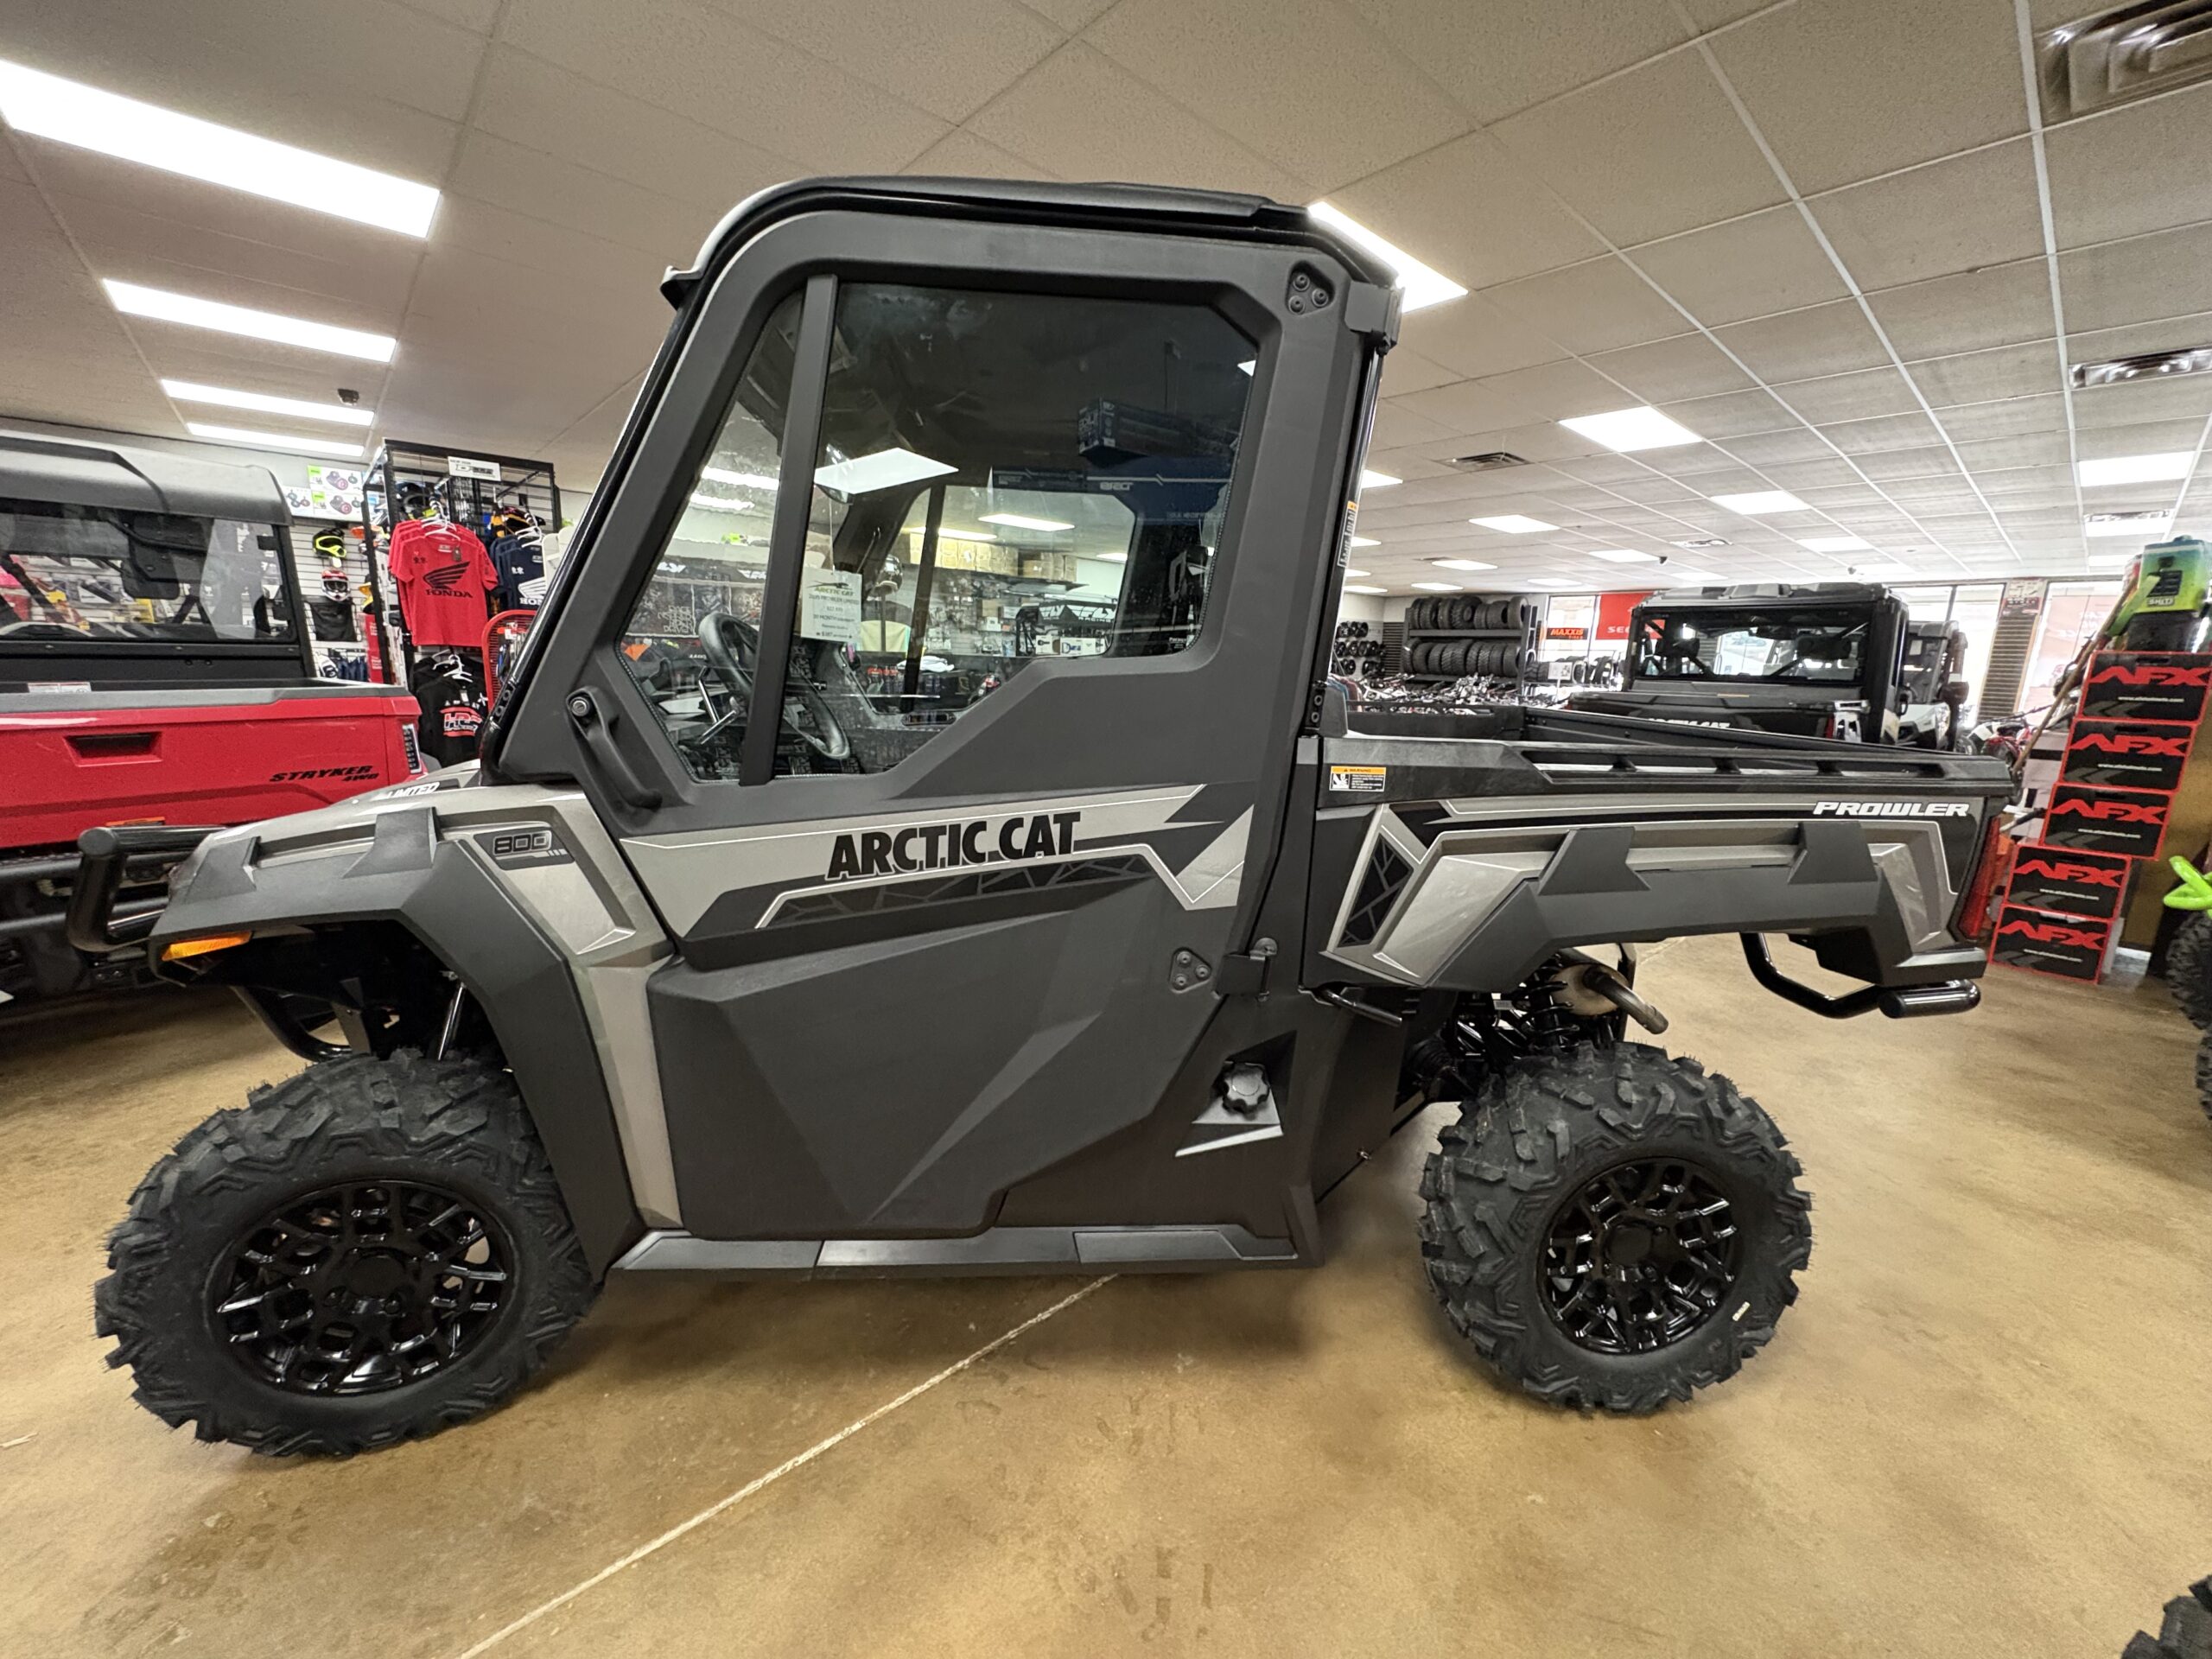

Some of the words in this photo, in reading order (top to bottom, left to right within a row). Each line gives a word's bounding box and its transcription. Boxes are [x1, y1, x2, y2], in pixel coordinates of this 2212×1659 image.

[426, 588, 473, 598] HONDA
[1067, 605, 1116, 620] FLY
[2088, 666, 2209, 685] AFX
[2069, 733, 2191, 757] AFX
[270, 766, 372, 782] STRYKER
[389, 781, 440, 798] LIMITED
[1813, 801, 1970, 817] PROWLER
[2050, 798, 2168, 825] AFX
[493, 830, 553, 856] 800
[826, 820, 988, 880] ARCTIC
[999, 810, 1081, 860] CAT
[2013, 859, 2126, 888] AFX
[1998, 919, 2107, 950] AFX
